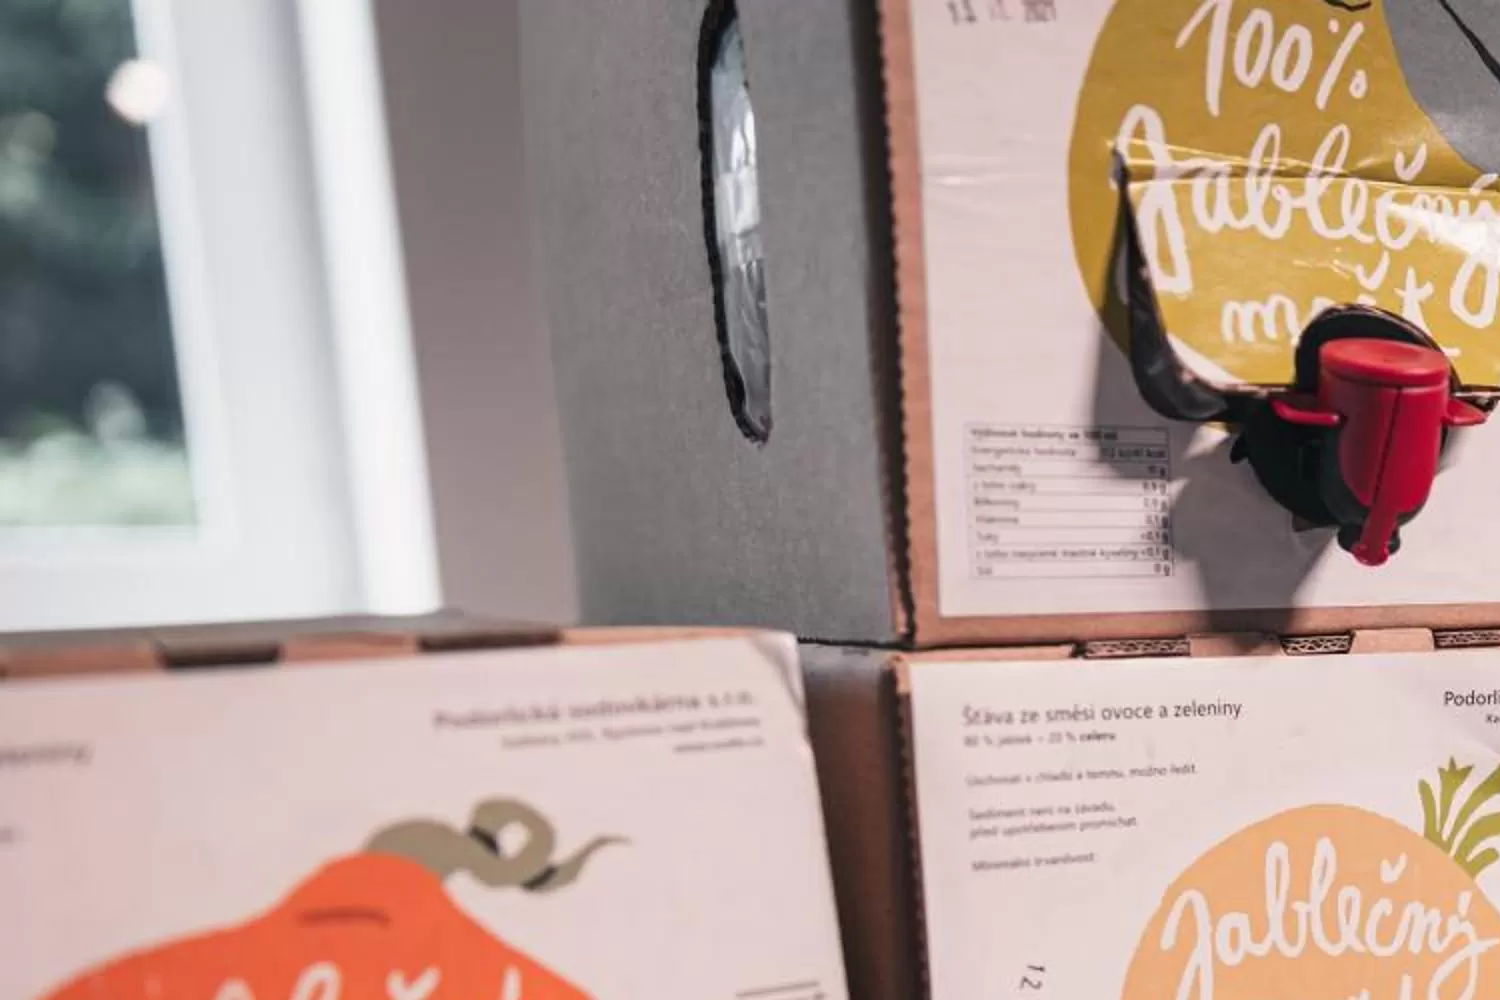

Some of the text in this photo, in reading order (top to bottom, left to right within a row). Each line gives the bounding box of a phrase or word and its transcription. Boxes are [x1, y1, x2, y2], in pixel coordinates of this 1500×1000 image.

[1176, 0, 1369, 117] 100%
[1220, 250, 1461, 358] mt
[1019, 710, 1040, 725] ze
[1045, 703, 1095, 722] směsi
[1101, 705, 1154, 721] ovoce
[1158, 705, 1169, 719] a
[1173, 697, 1243, 720] zeleniny
